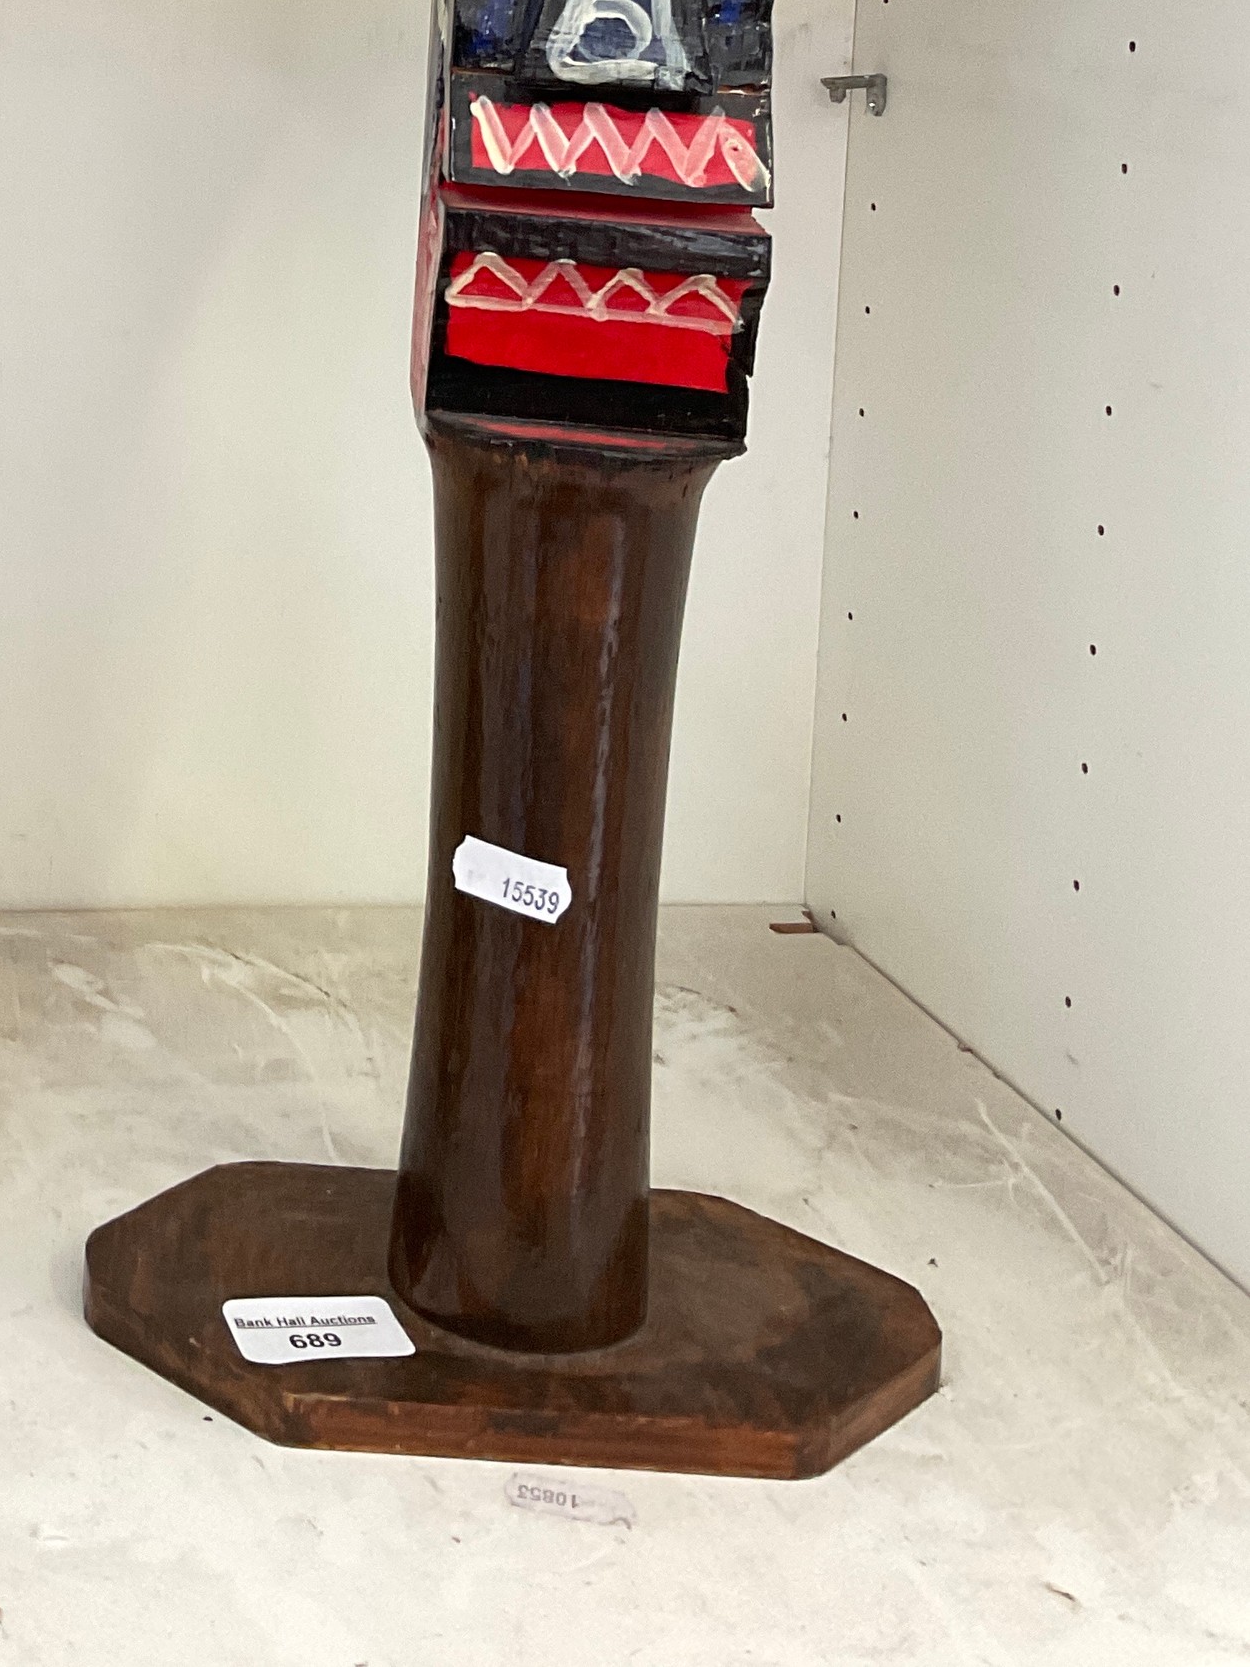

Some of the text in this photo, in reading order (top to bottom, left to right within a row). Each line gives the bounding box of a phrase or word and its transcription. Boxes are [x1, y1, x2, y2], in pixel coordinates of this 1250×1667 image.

[502, 877, 560, 914] 15539
[234, 1315, 376, 1328] Bank Hall Auctions
[289, 1333, 342, 1349] 689
[516, 1484, 580, 1509] 10853
